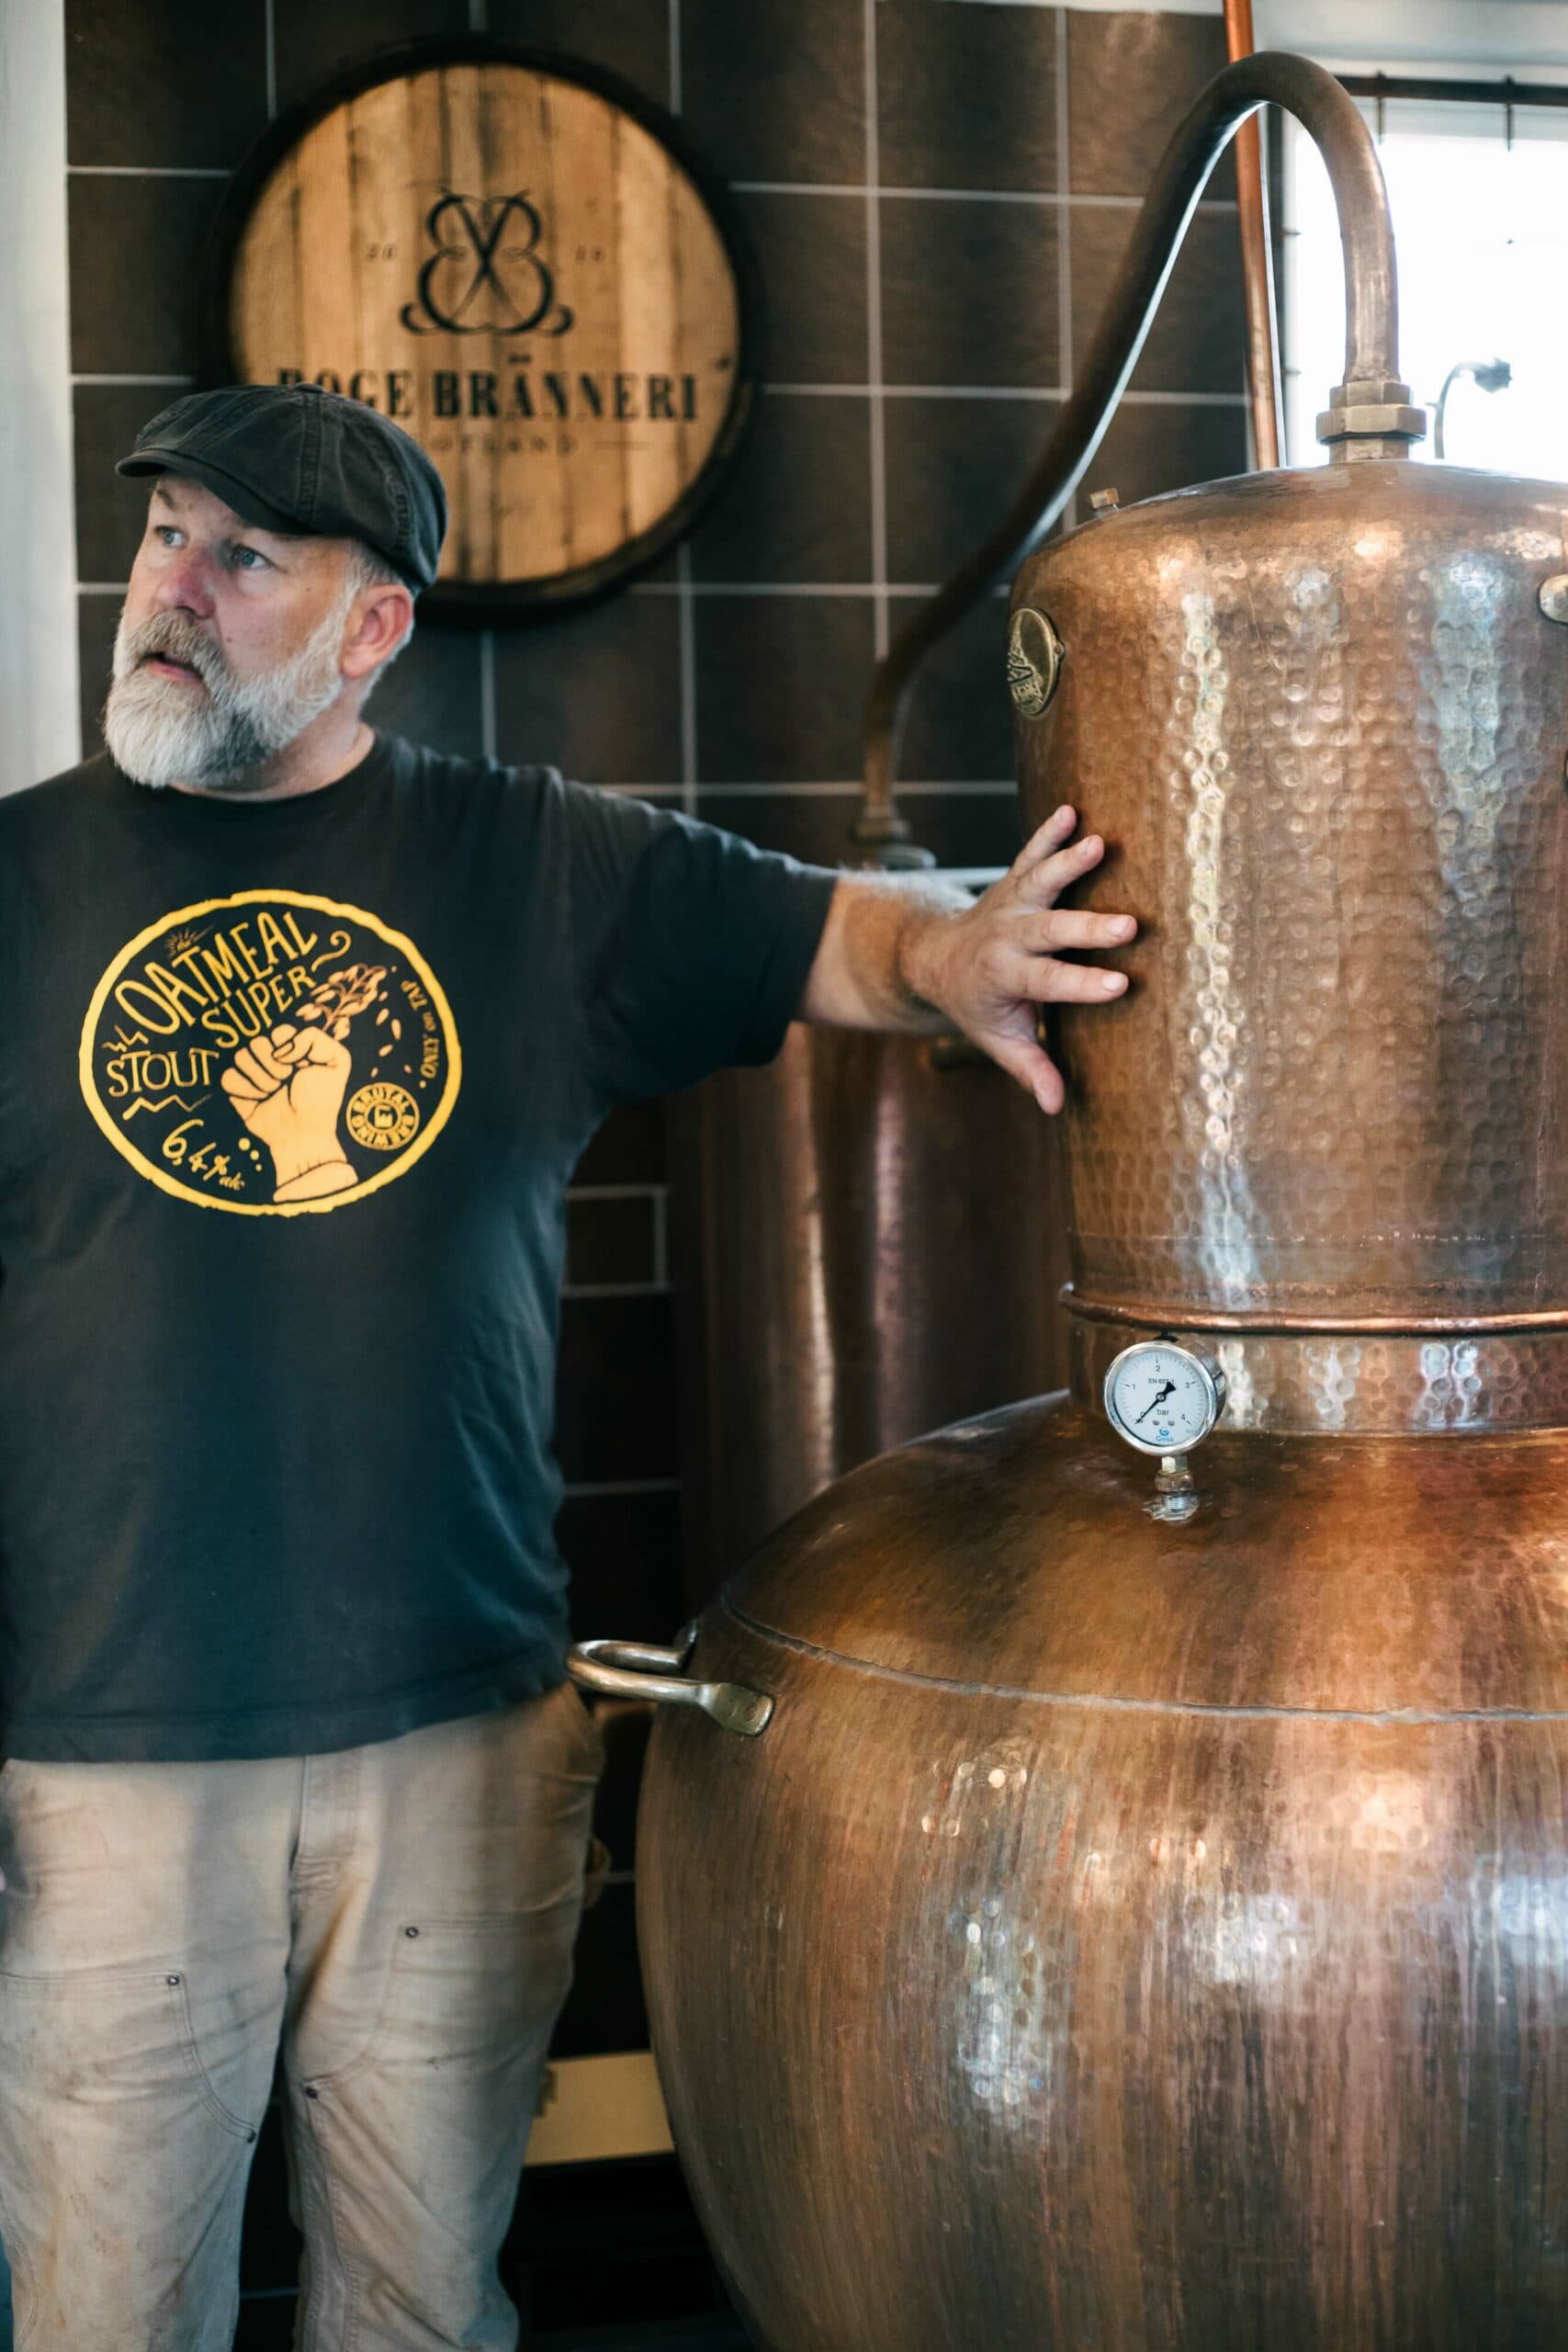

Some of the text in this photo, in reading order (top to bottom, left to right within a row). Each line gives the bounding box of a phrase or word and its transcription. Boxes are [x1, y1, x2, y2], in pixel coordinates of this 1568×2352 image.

[434, 353, 697, 422] BRÄNNERI
[115, 911, 318, 1035] OATMEAL
[201, 965, 316, 1048] SUPER
[107, 1047, 220, 1097] STOUT
